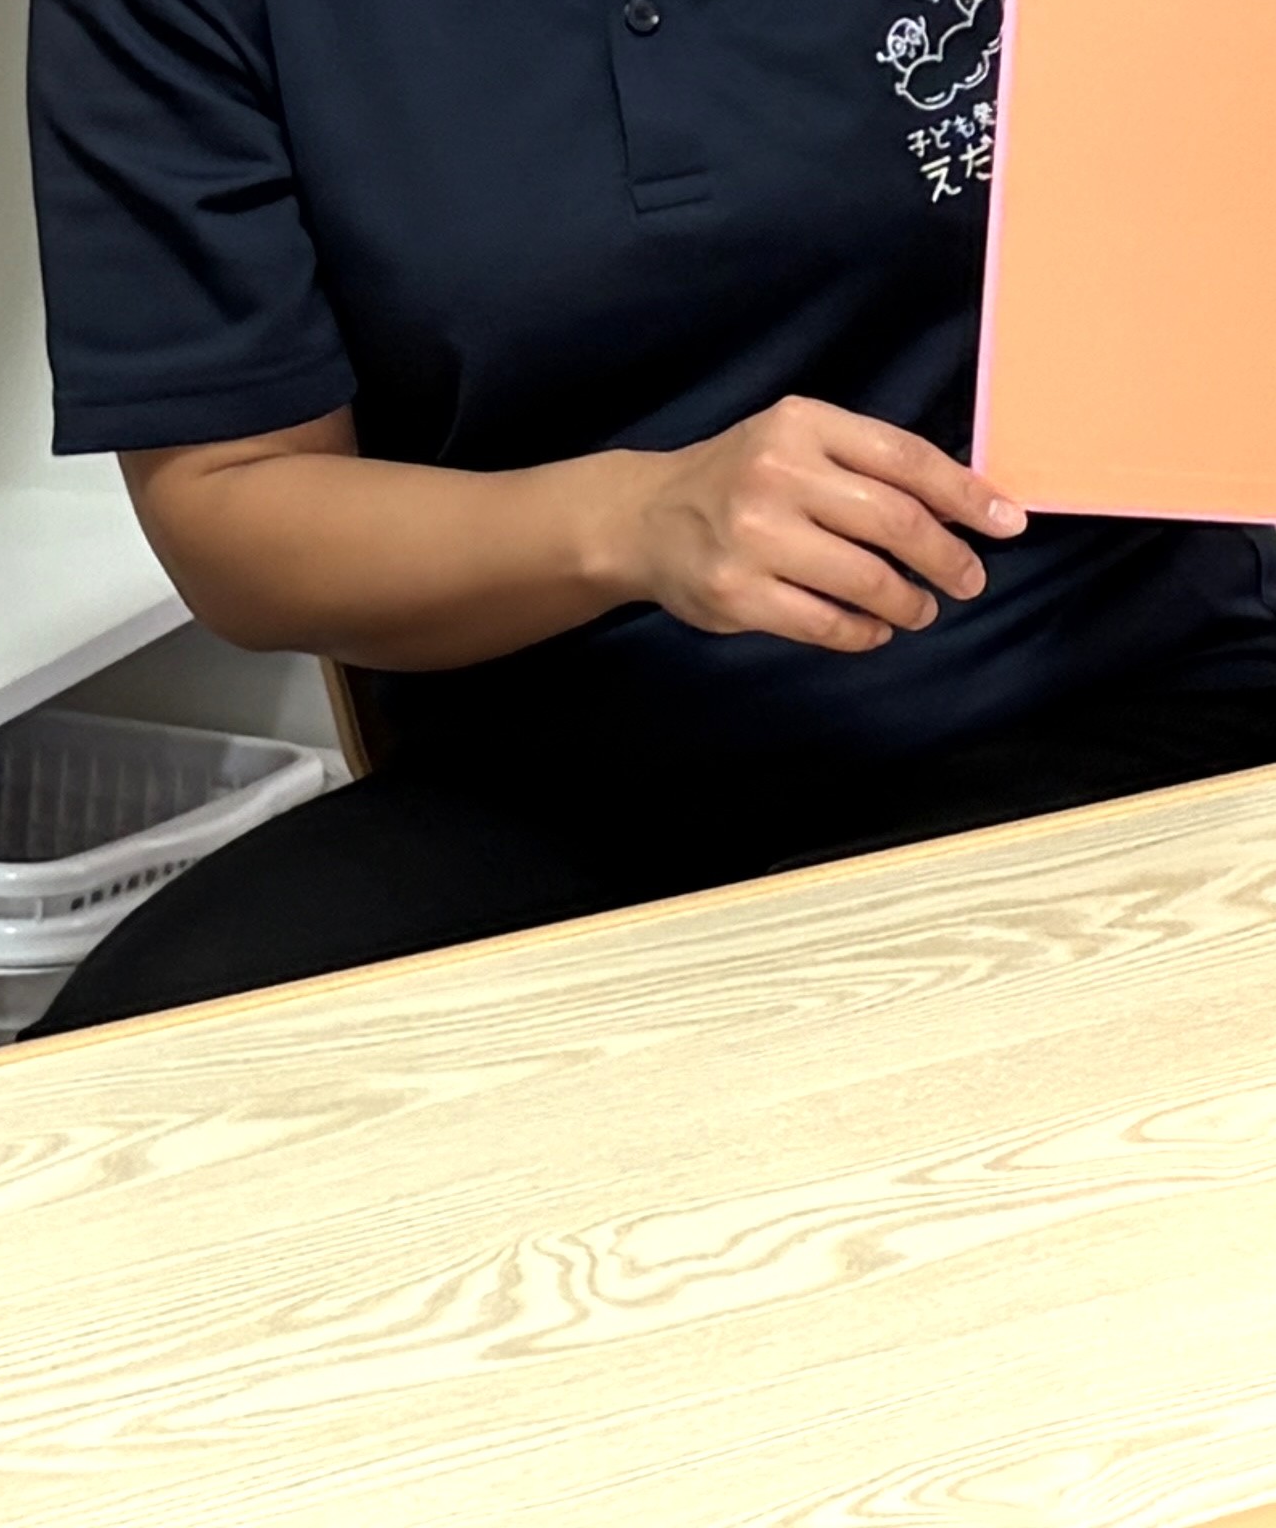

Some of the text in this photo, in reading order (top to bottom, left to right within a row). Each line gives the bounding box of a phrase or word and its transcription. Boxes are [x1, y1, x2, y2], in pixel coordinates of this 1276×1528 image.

[907, 100, 997, 159] 子ども発
[920, 133, 994, 204] えだ
